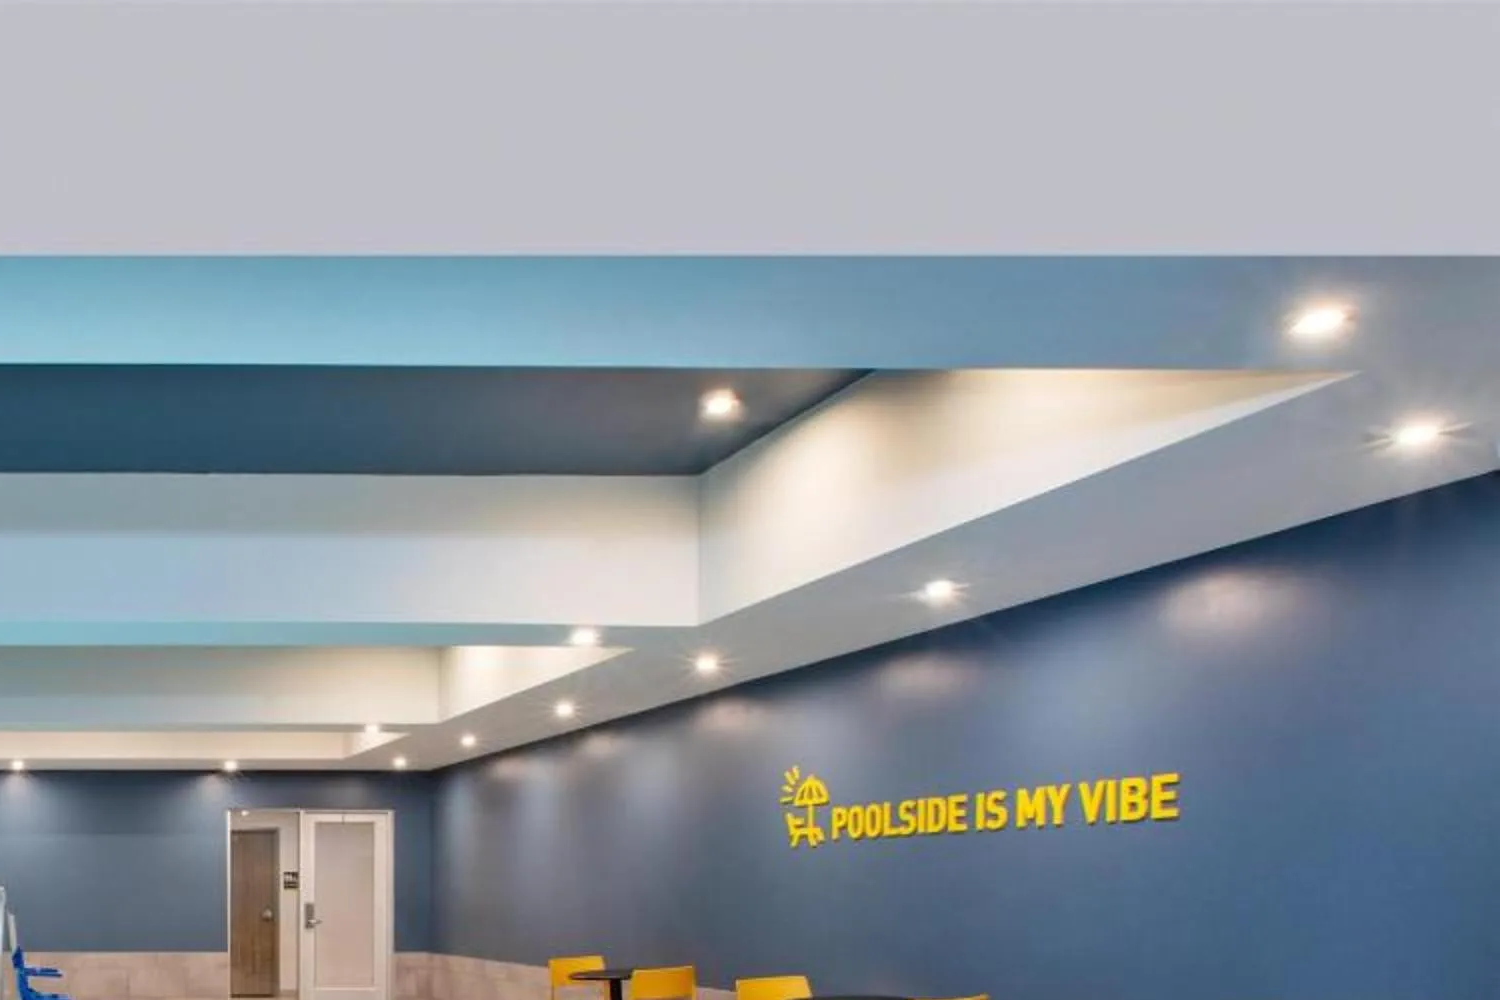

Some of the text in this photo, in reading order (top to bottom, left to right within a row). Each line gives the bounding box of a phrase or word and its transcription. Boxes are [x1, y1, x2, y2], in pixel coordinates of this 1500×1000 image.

[831, 772, 1181, 841] POOLSIDE IS MY VIBE
